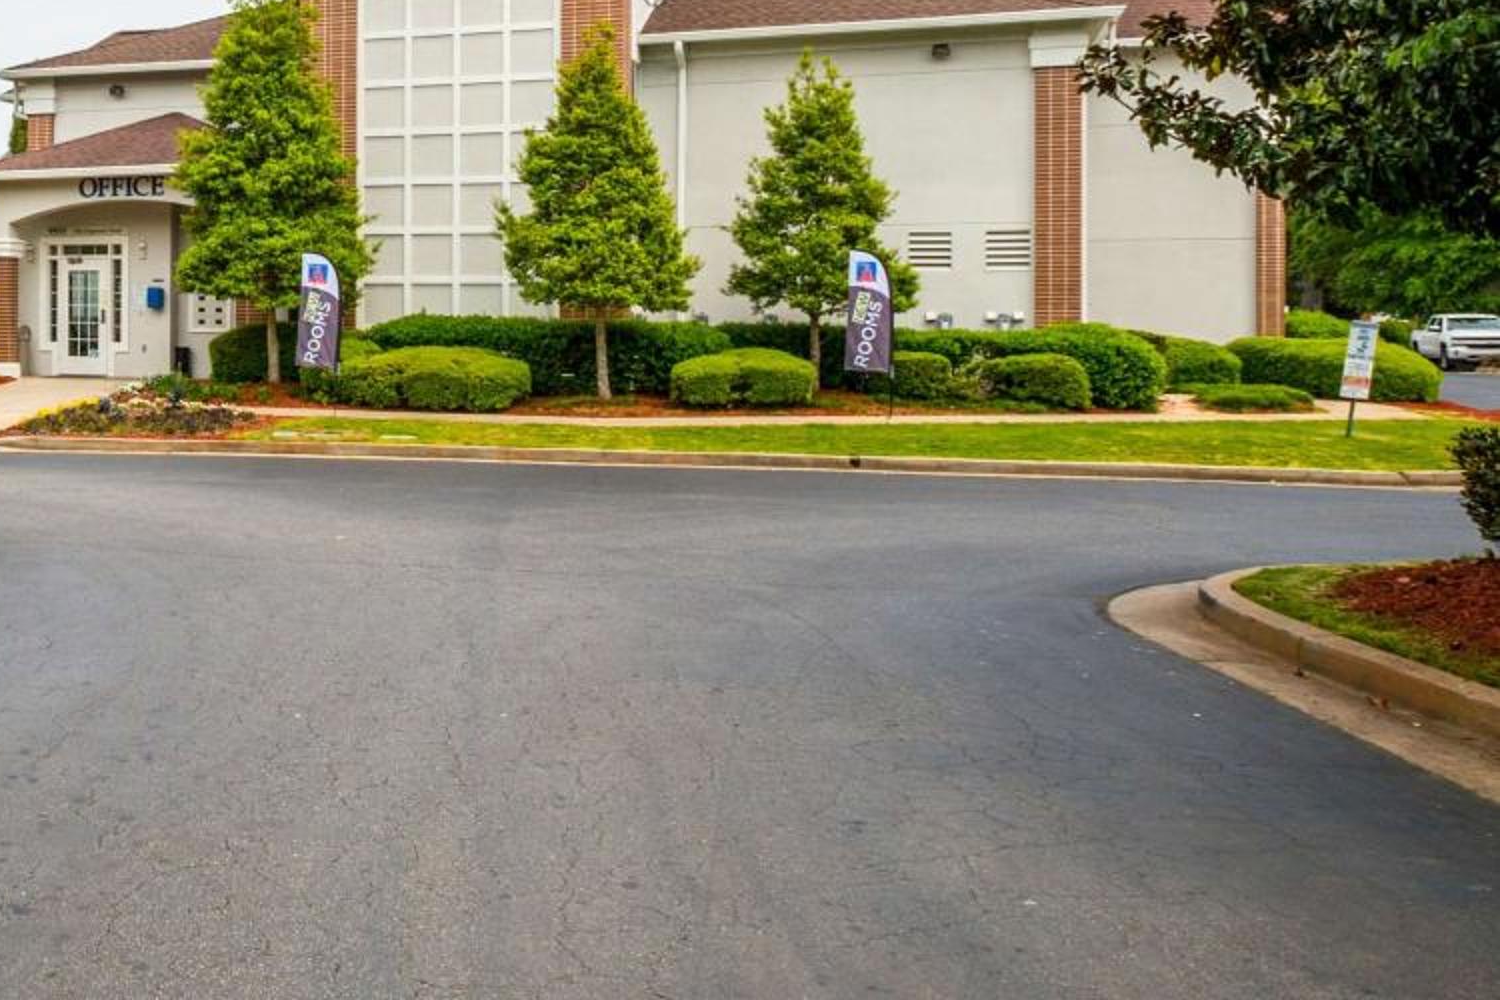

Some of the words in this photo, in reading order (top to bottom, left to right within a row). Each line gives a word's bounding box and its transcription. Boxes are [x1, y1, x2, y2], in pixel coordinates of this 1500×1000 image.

[78, 175, 165, 199] OFFICE
[303, 300, 331, 364] ROOMS
[853, 301, 883, 369] ROOMS
